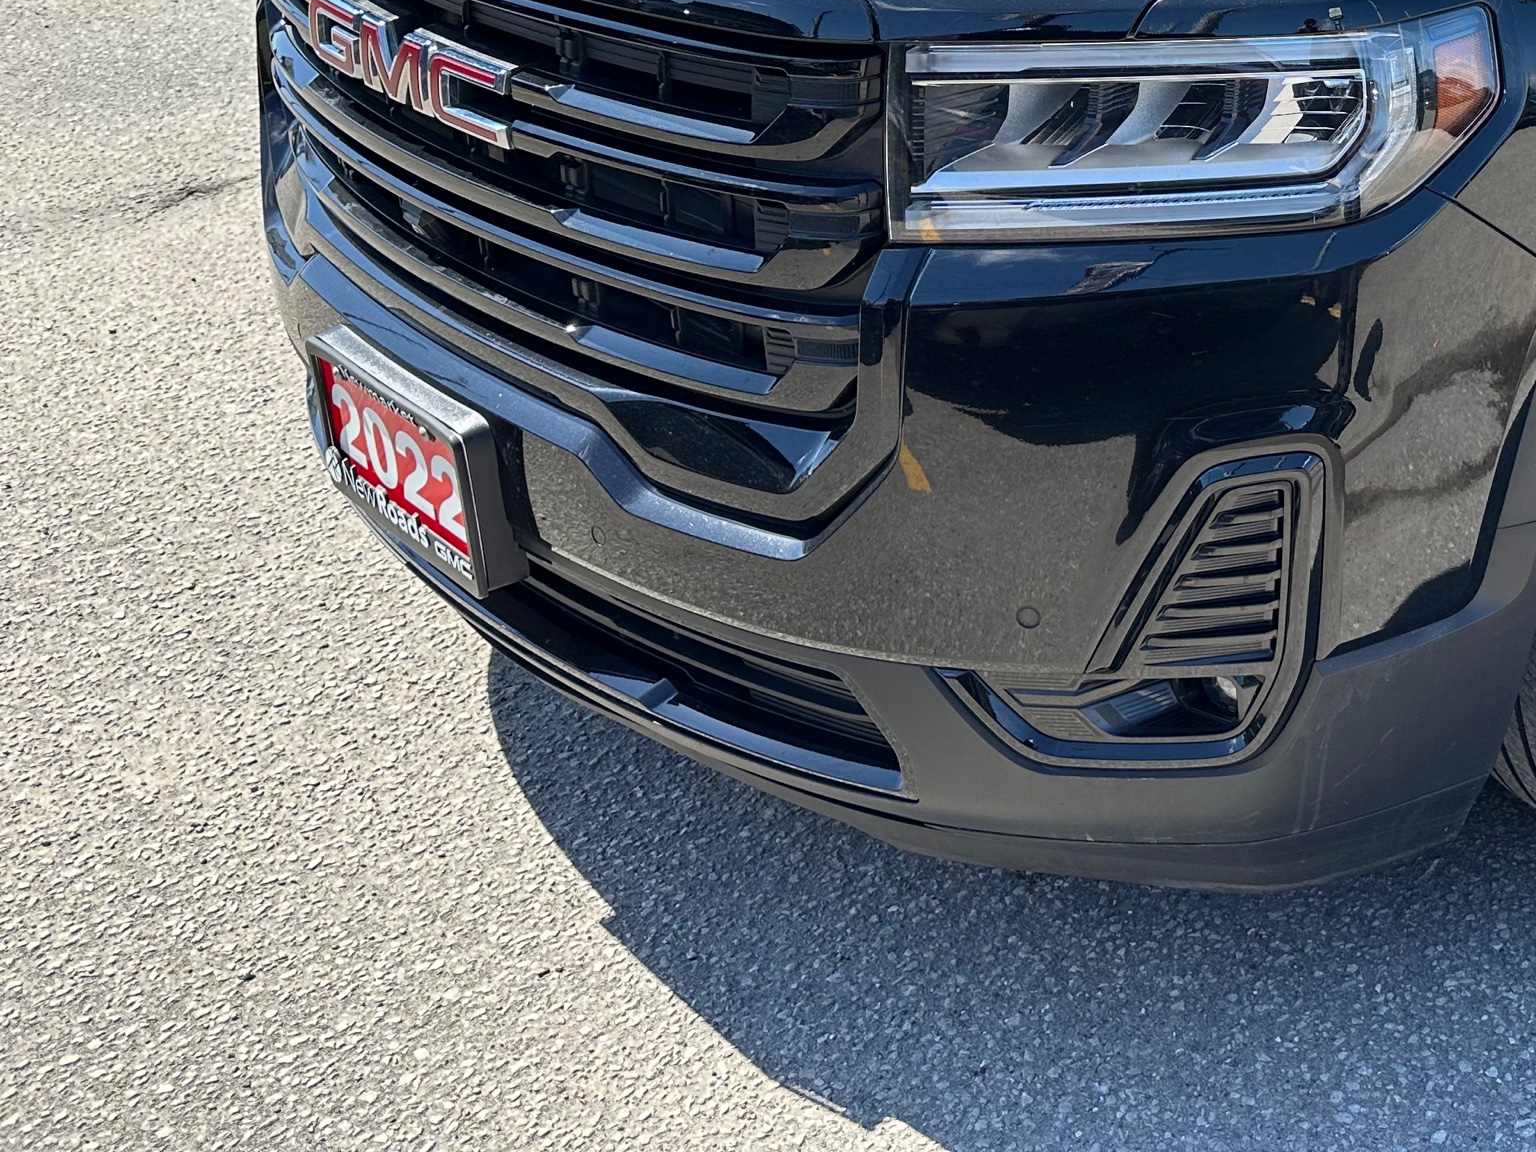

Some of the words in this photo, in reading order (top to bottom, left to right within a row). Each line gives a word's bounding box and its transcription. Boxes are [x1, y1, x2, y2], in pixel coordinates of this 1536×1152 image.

[331, 382, 468, 544] 2022
[341, 456, 431, 549] NewRoads
[433, 539, 474, 581] GMC
